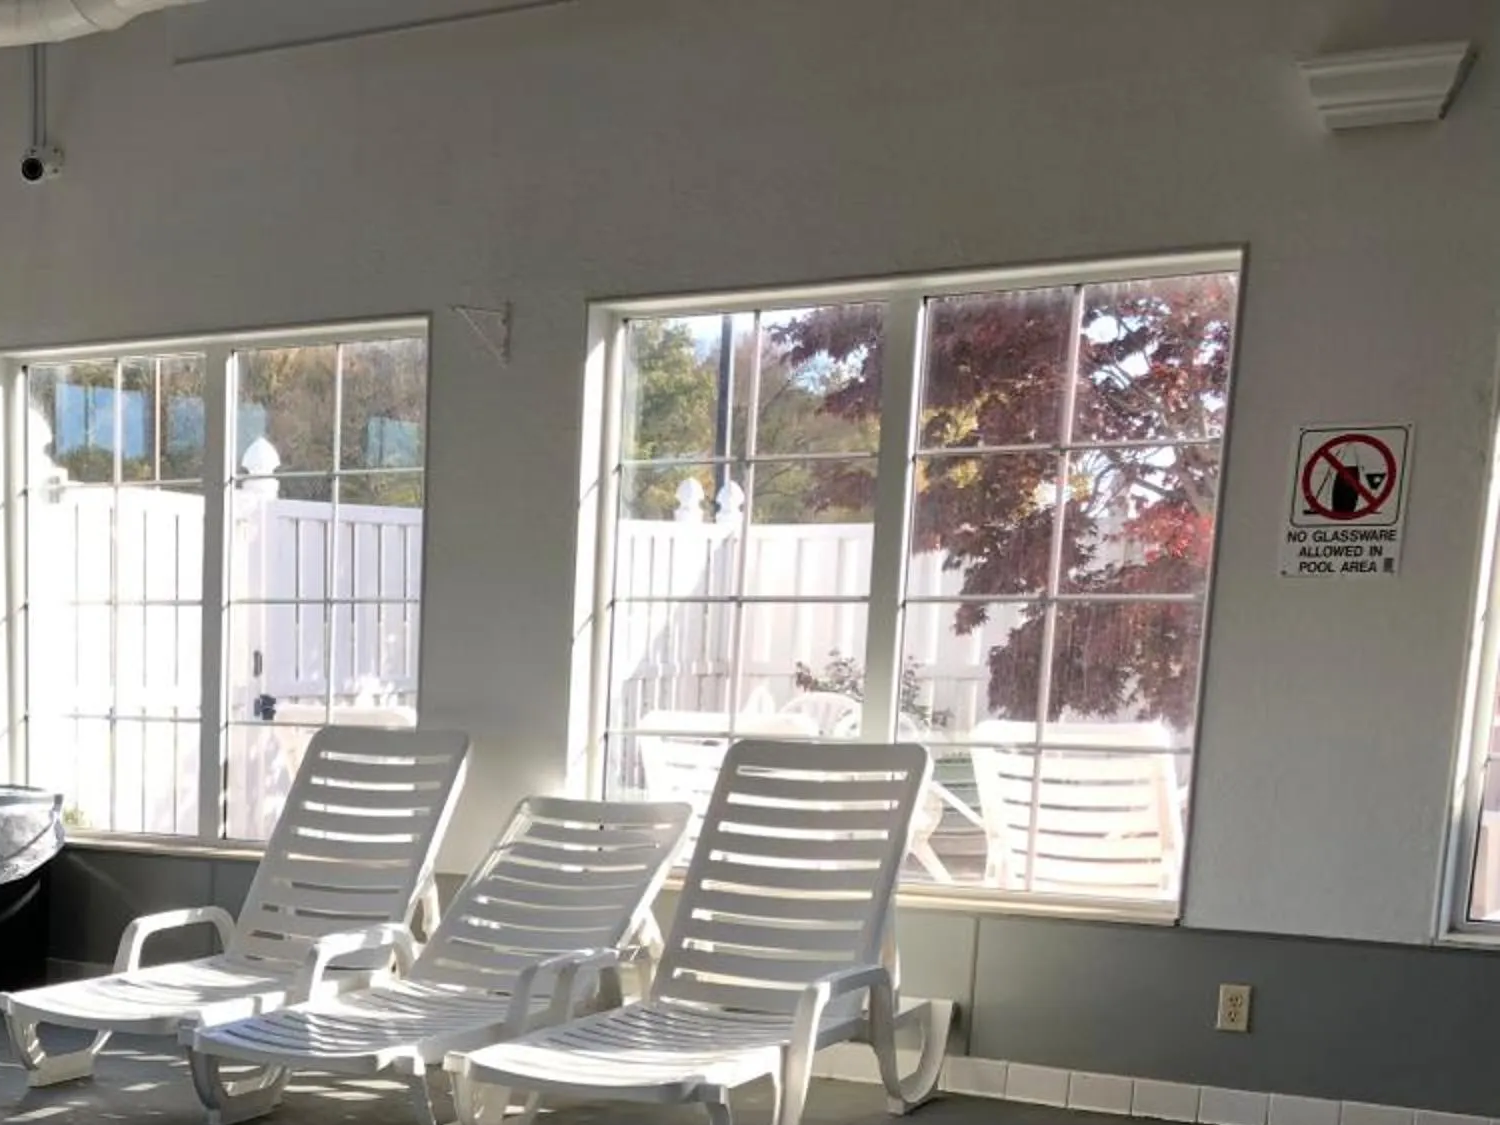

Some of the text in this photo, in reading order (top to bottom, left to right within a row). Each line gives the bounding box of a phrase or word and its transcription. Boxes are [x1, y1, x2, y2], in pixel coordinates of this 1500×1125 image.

[1287, 529, 1397, 543] NO GLASSWARE
[1298, 545, 1383, 557] ALLOWED IN
[1298, 560, 1378, 573] POOL AREA
